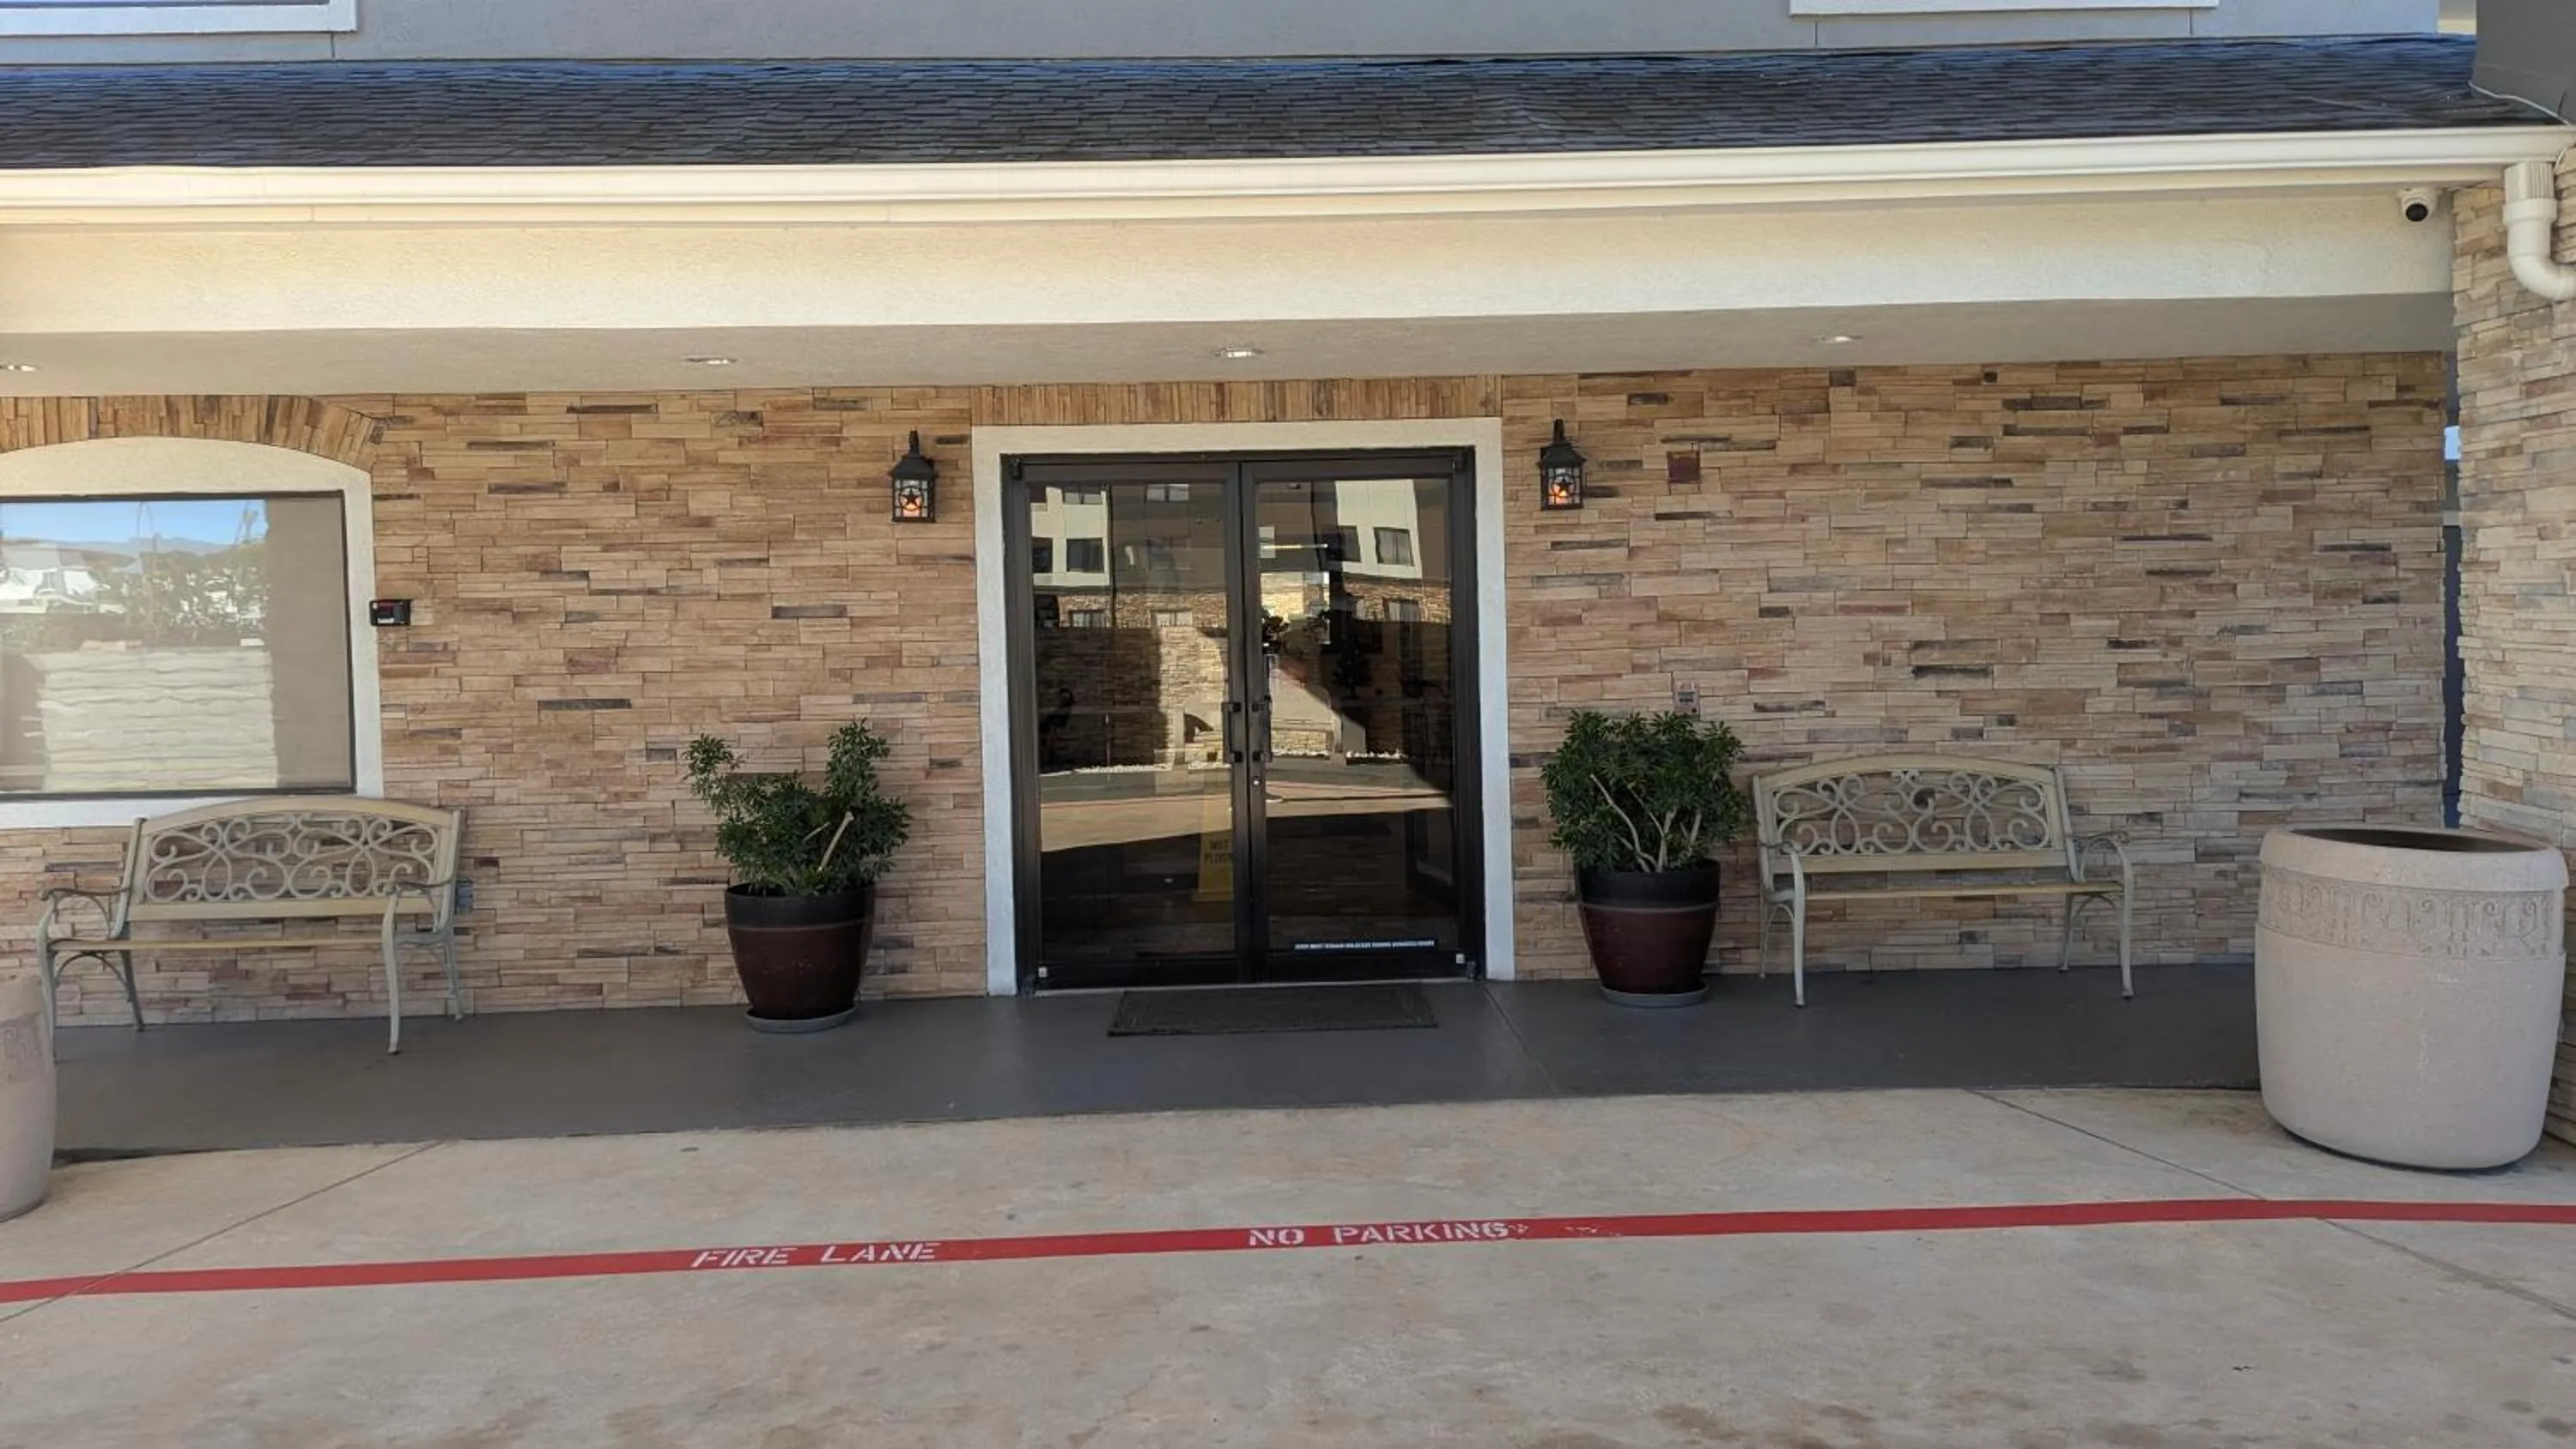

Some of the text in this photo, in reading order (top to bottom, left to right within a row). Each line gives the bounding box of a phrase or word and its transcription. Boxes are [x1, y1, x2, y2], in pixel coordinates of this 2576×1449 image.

[1249, 1221, 1510, 1246] NO PARKING
[690, 1242, 941, 1268] FIRE LANE
